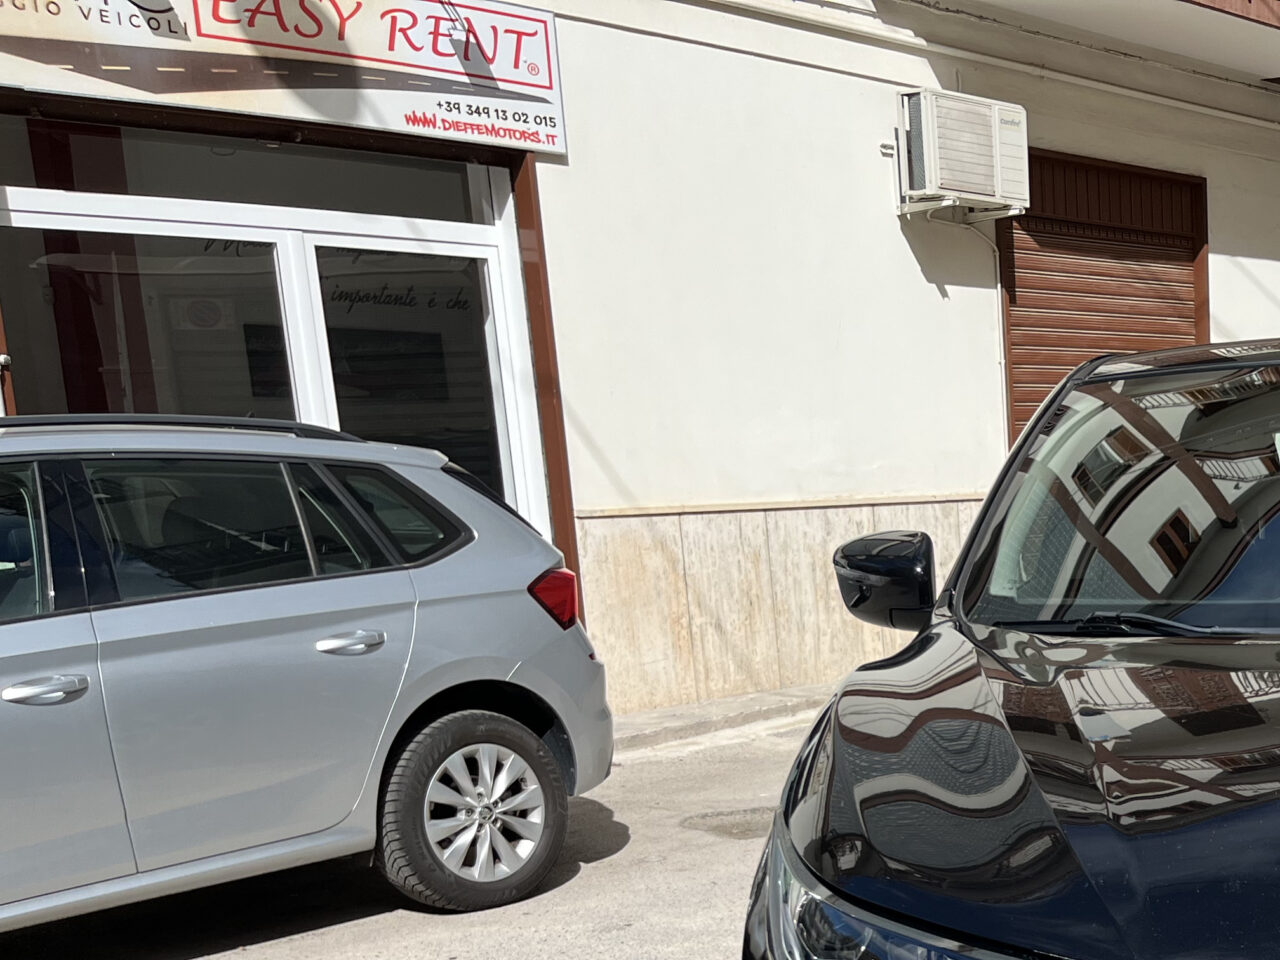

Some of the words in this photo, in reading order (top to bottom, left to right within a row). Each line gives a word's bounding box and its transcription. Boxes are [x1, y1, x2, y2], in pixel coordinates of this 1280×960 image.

[0, 0, 61, 16] GIO
[79, 5, 188, 36] VEICOLI
[380, 8, 538, 70] RENT
[437, 101, 461, 114] +39
[466, 104, 490, 119] 349
[494, 109, 508, 121] 13
[512, 111, 530, 124] 02
[533, 115, 557, 128] 015
[331, 283, 416, 314] importante
[446, 287, 471, 310] che
